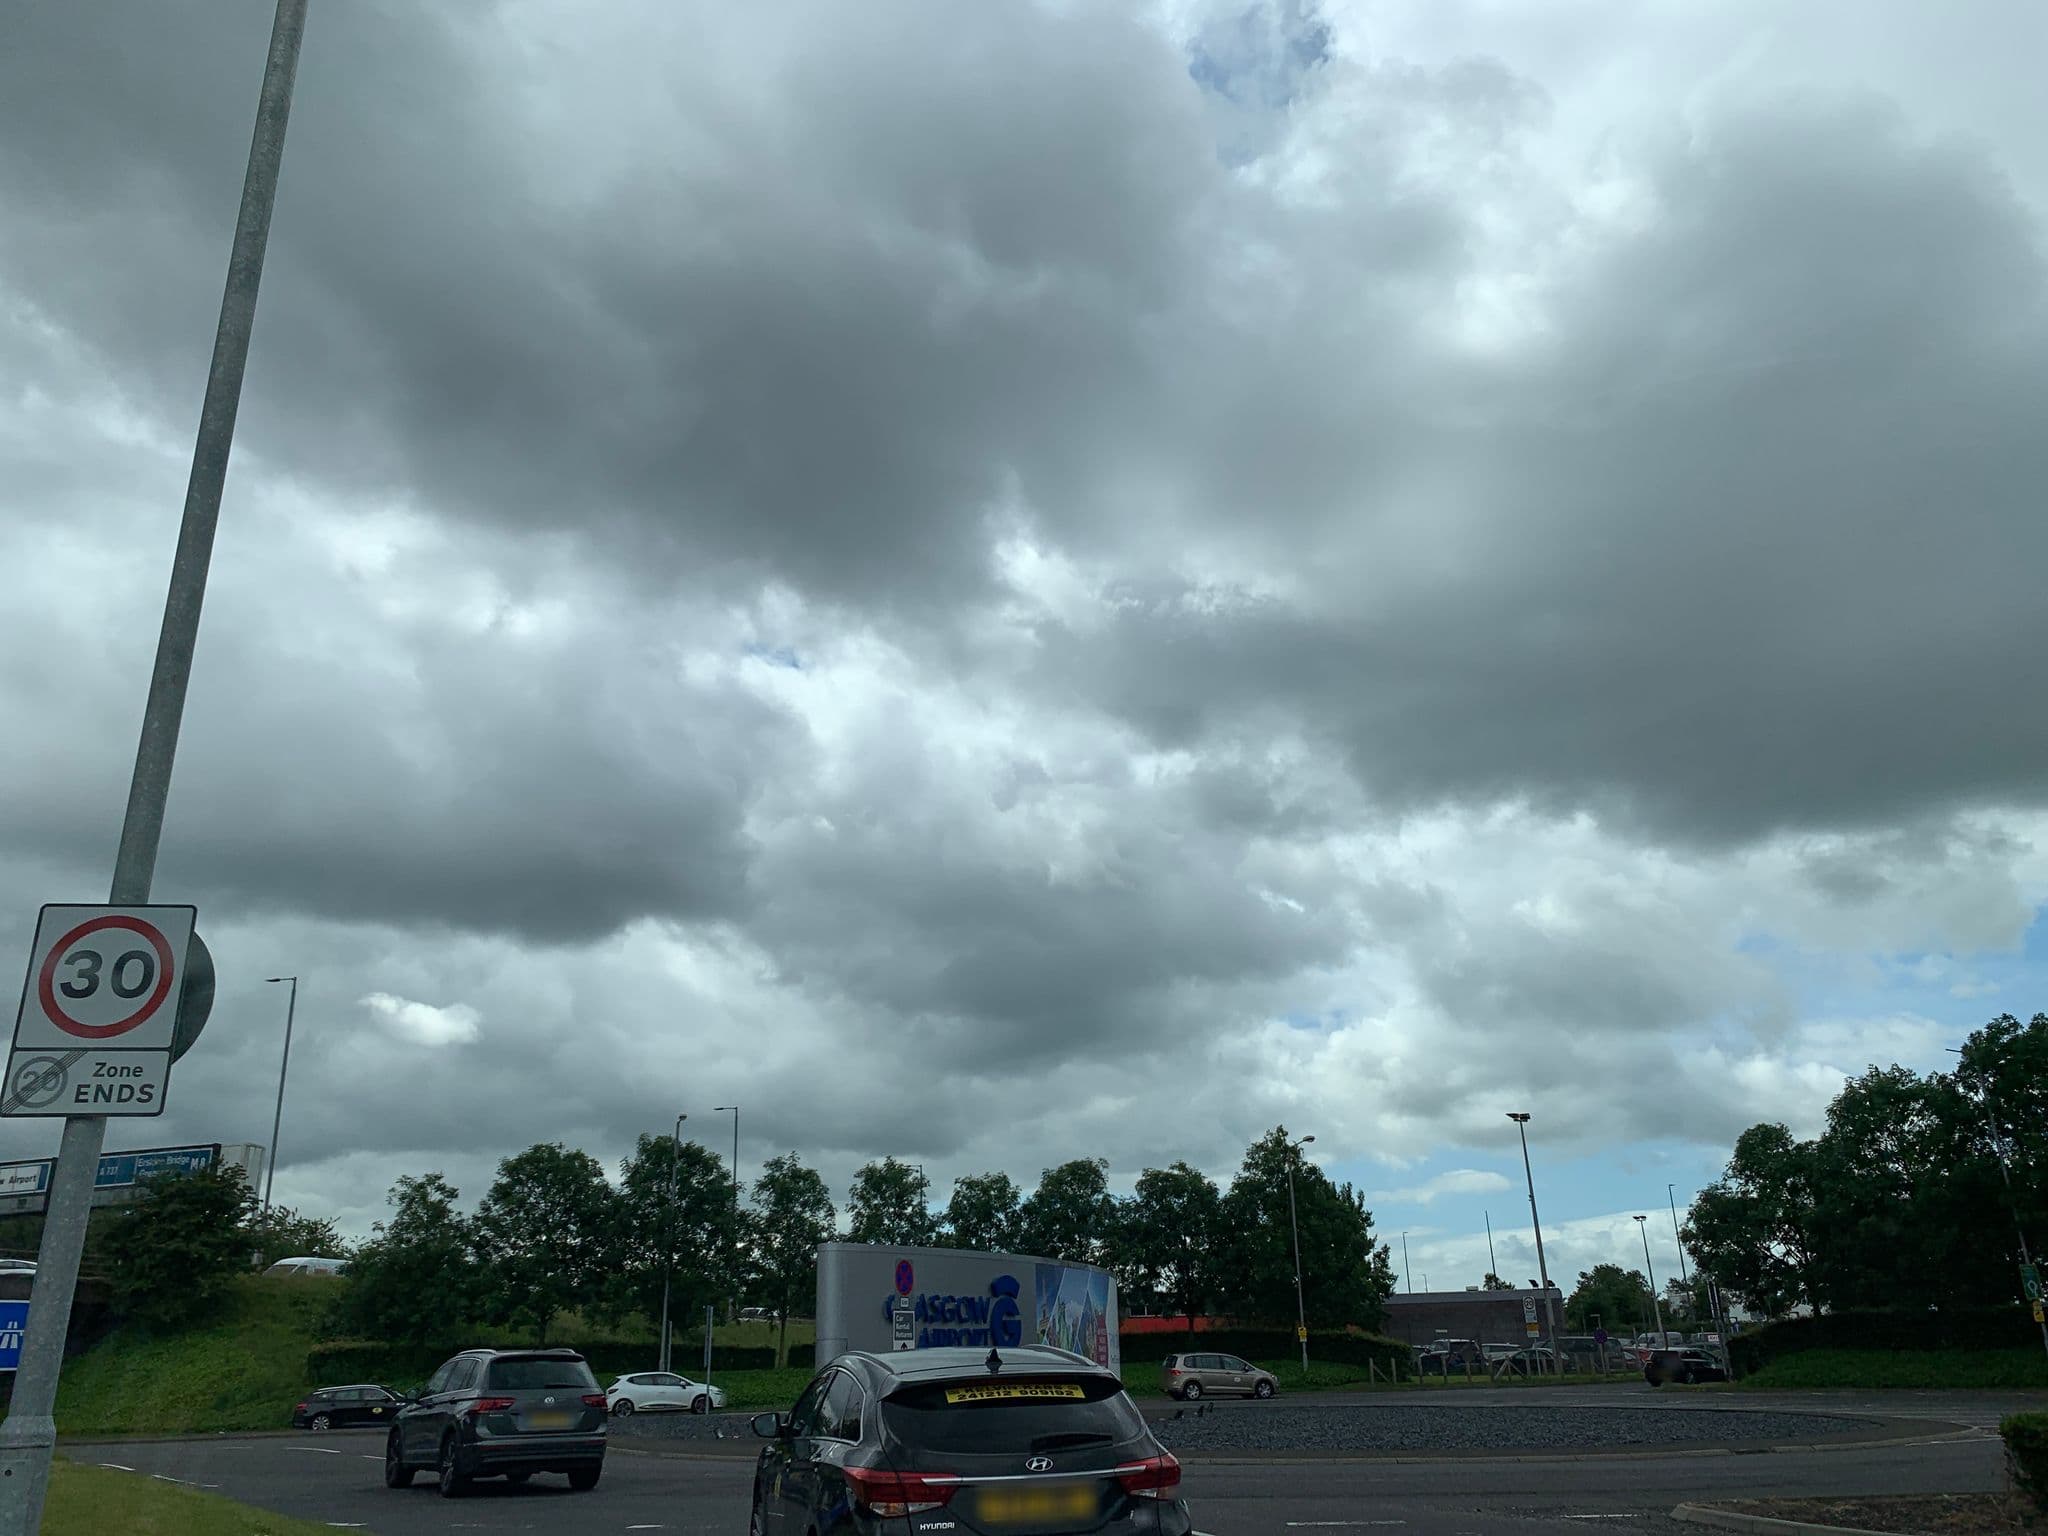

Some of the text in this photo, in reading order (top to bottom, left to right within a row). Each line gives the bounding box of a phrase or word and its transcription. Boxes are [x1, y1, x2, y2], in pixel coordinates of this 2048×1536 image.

[60, 950, 155, 999] 30
[93, 1062, 143, 1078] Zone
[23, 1070, 59, 1092] 20
[74, 1083, 155, 1103] ENDS
[9, 1174, 37, 1185] Airport
[958, 1390, 1011, 1400] 241212
[920, 1522, 955, 1531] HYUNDAI
